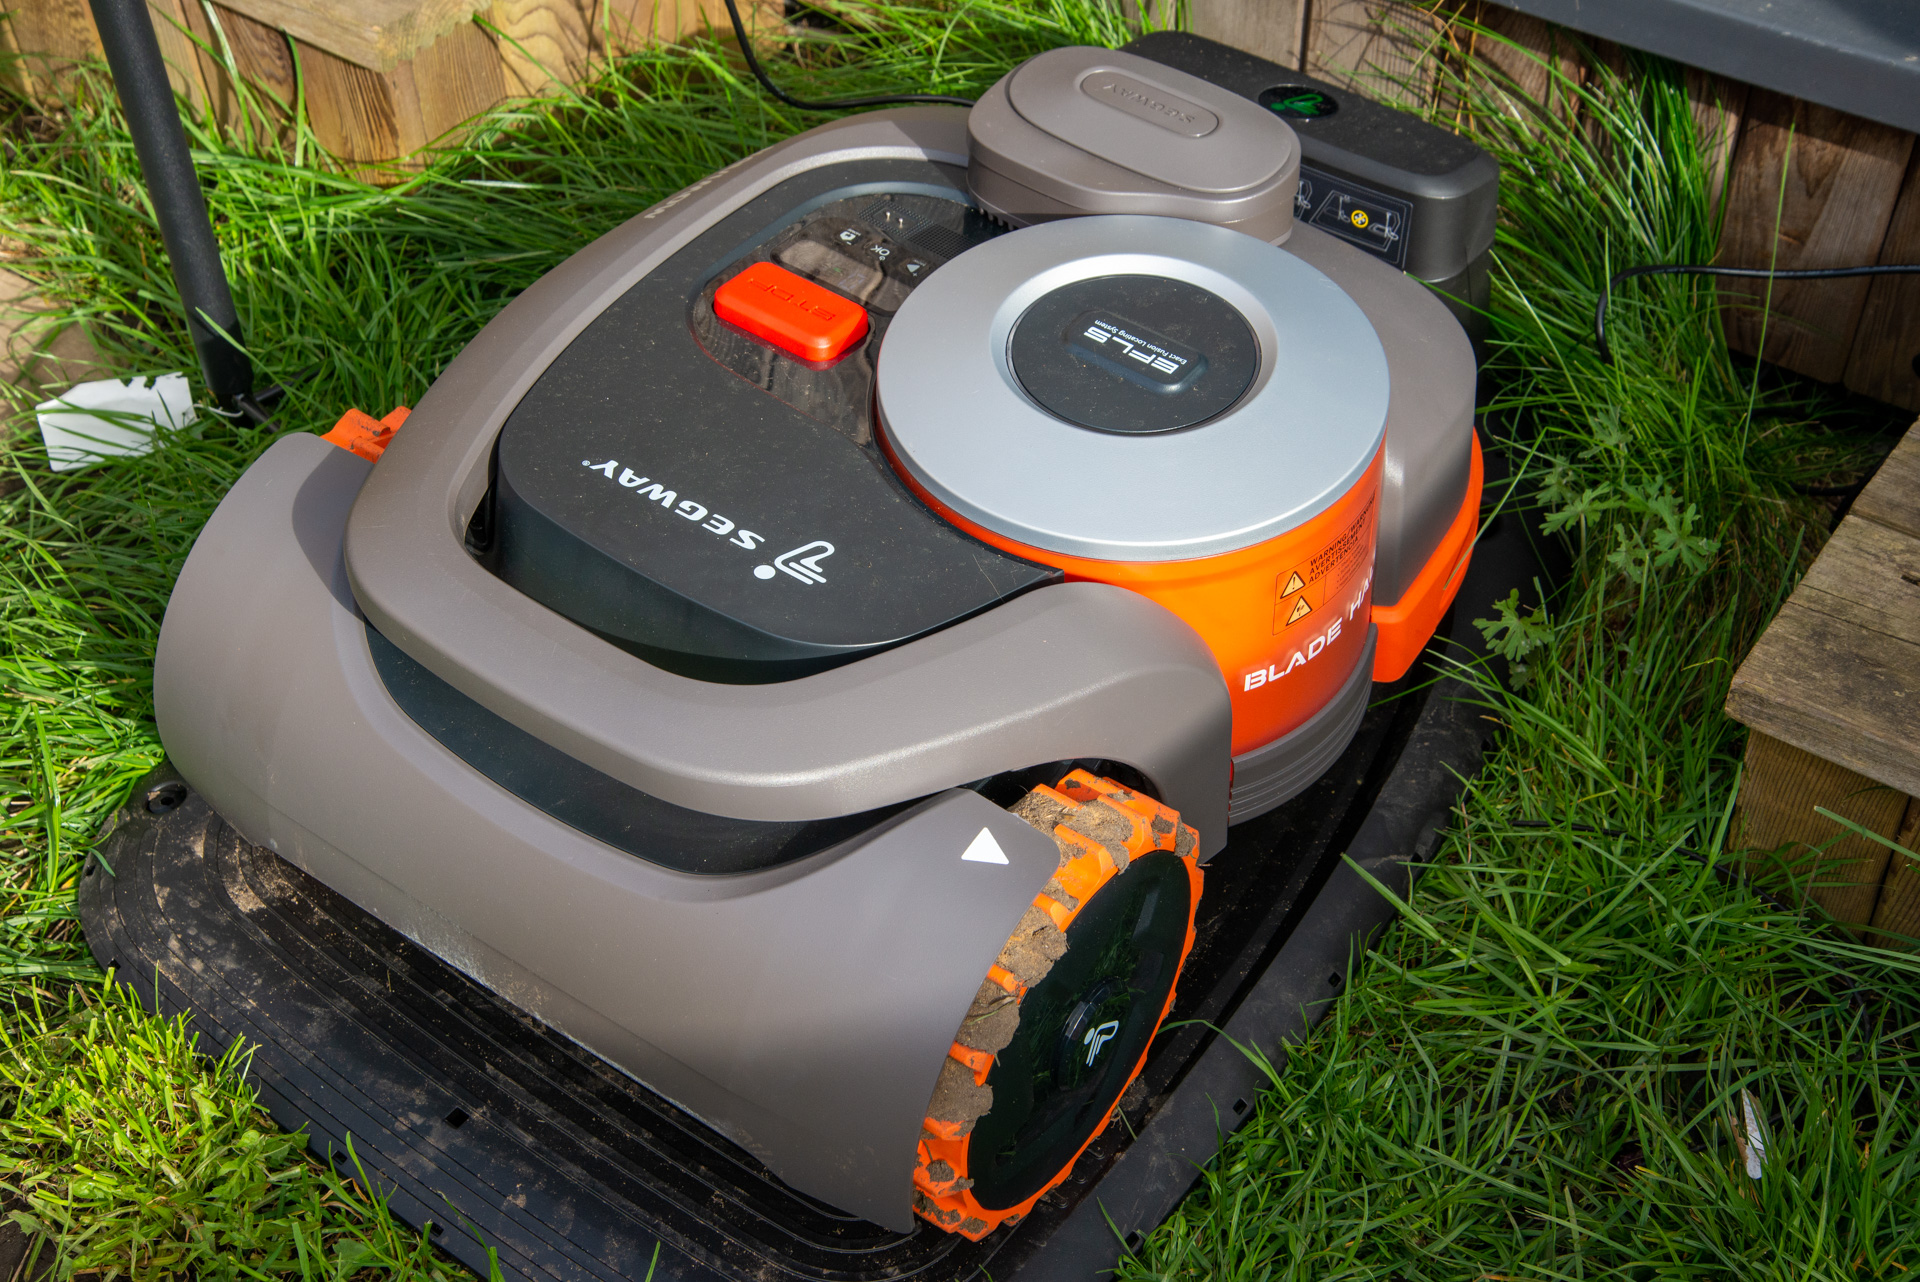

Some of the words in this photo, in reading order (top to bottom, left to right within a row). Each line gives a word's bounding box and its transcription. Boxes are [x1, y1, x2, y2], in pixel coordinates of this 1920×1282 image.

[1103, 84, 1195, 123] SEGWAY
[870, 244, 890, 256] OK
[747, 277, 838, 321] STOP
[1095, 320, 1119, 334] System
[1118, 330, 1147, 347] Locating
[1083, 326, 1179, 374] EFLS
[1146, 343, 1169, 357] Fusion
[1168, 353, 1187, 365] Exact
[1308, 536, 1358, 584] ADVERTENCIA
[1309, 518, 1365, 575] AVERTISSEMENT
[1244, 617, 1342, 692] BLADE
